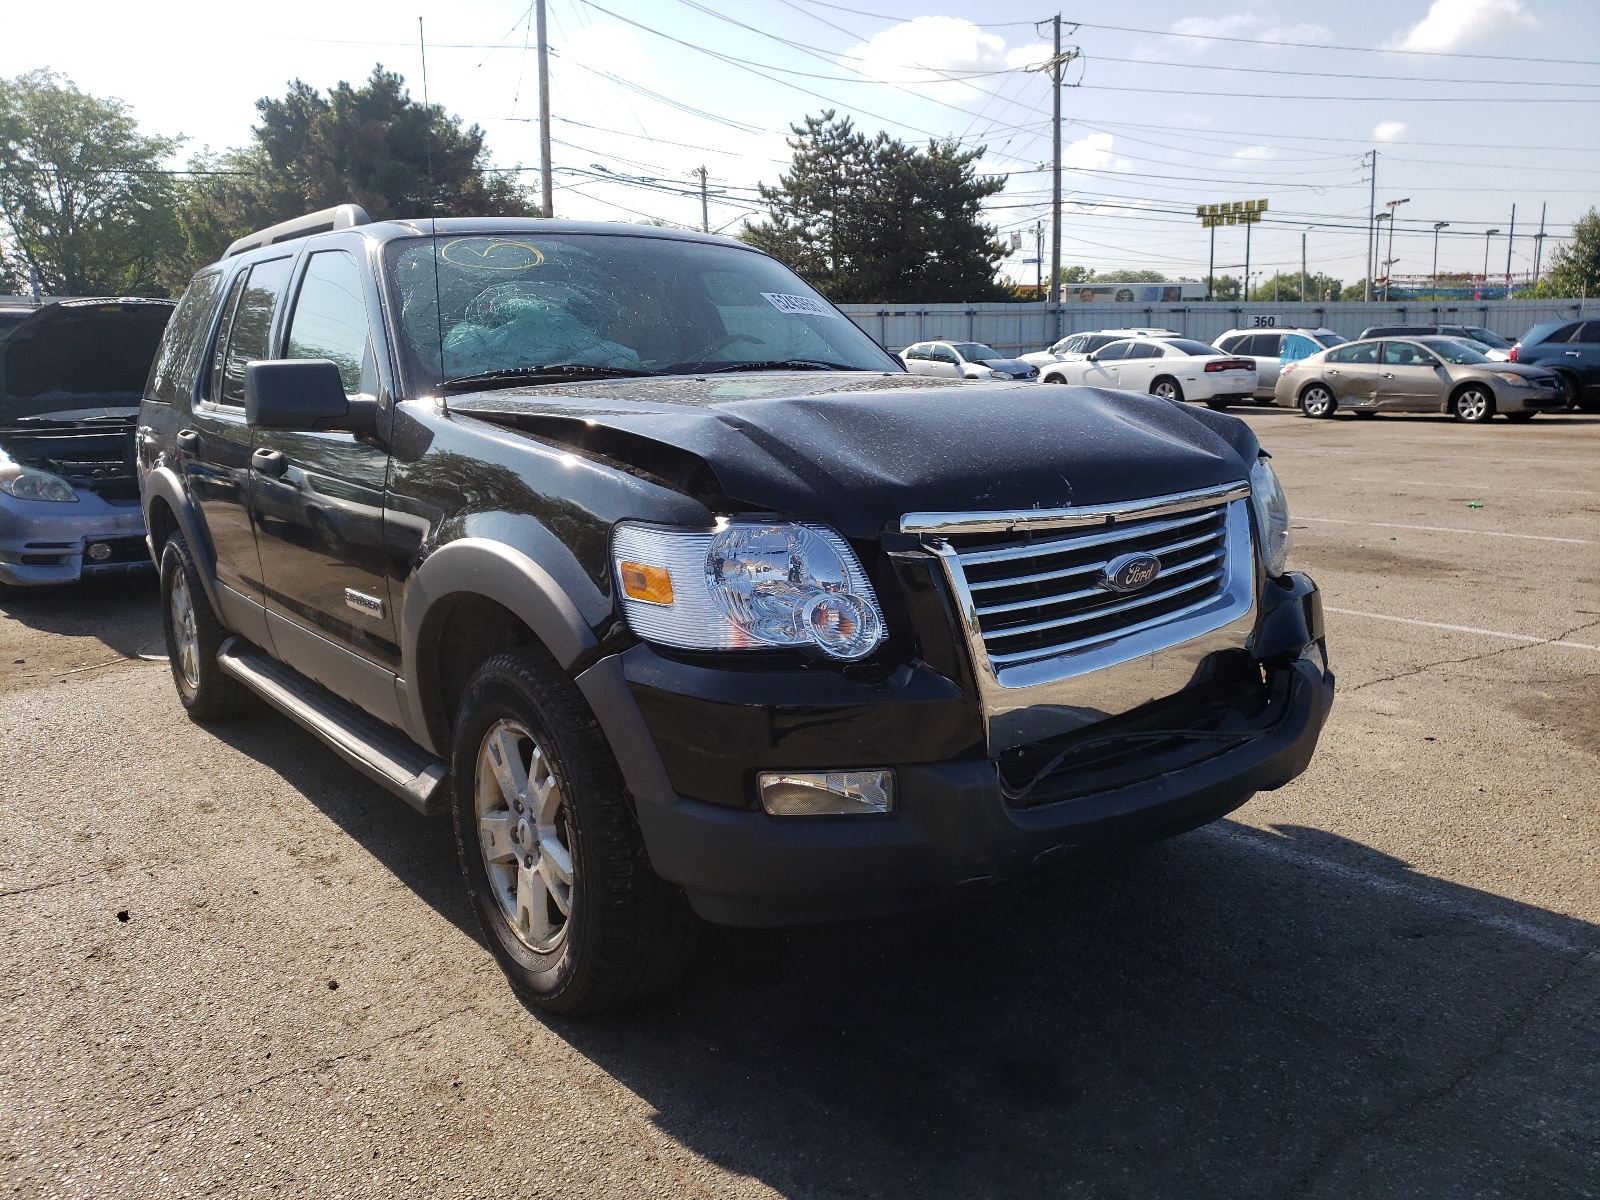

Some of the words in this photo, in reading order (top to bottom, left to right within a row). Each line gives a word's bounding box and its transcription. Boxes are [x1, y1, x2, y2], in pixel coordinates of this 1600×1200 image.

[1197, 200, 1267, 216] WAFFLE
[1203, 212, 1261, 227] HOUSE
[1253, 316, 1275, 327] 360
[1125, 560, 1154, 584] Ford
